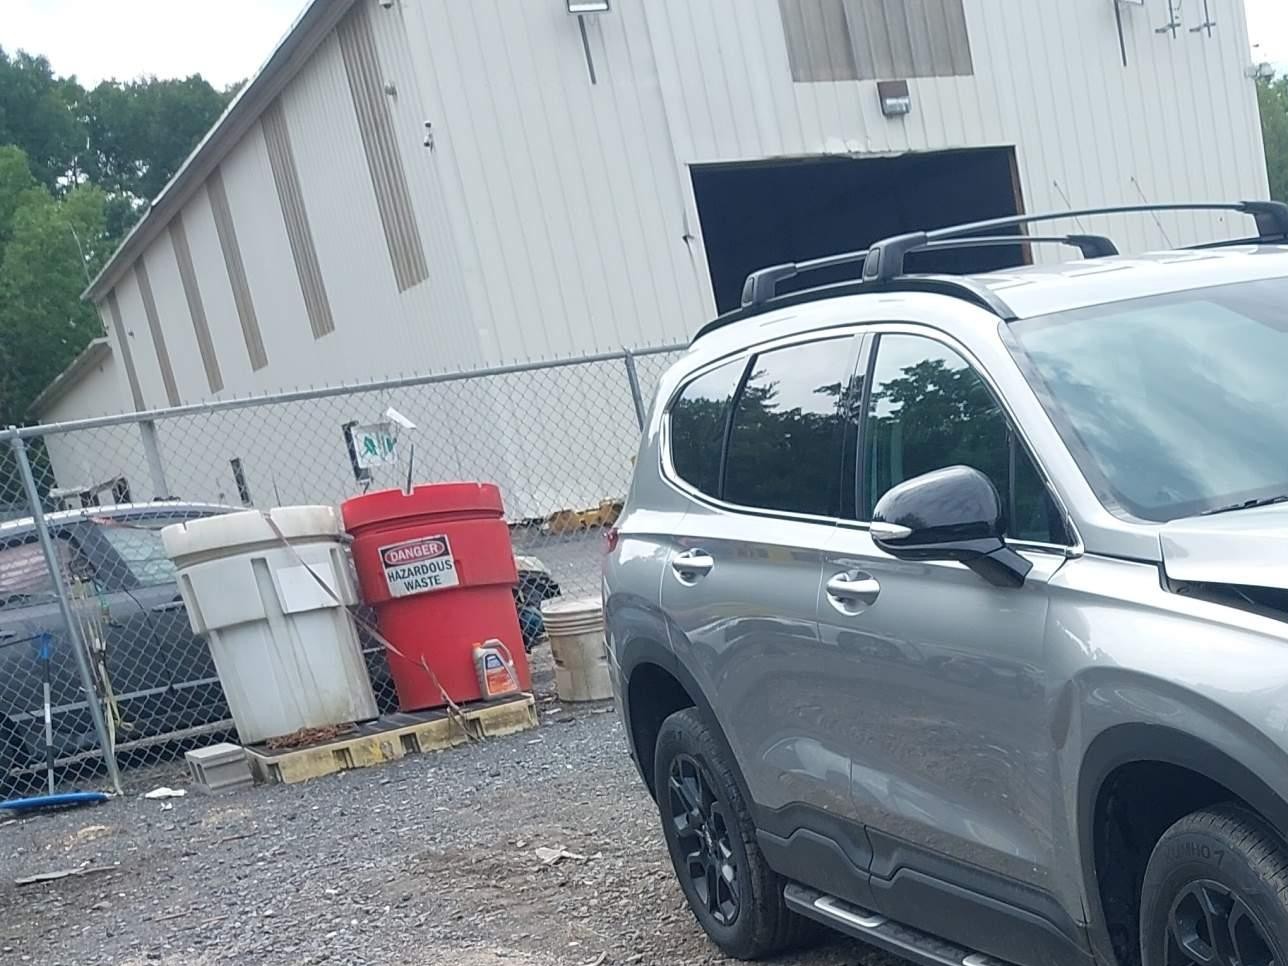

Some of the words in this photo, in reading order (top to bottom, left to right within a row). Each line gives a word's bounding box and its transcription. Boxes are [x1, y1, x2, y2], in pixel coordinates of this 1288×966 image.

[390, 543, 438, 562] DANGER
[388, 560, 453, 583] HAZARDOUS
[404, 575, 442, 592] WASTE
